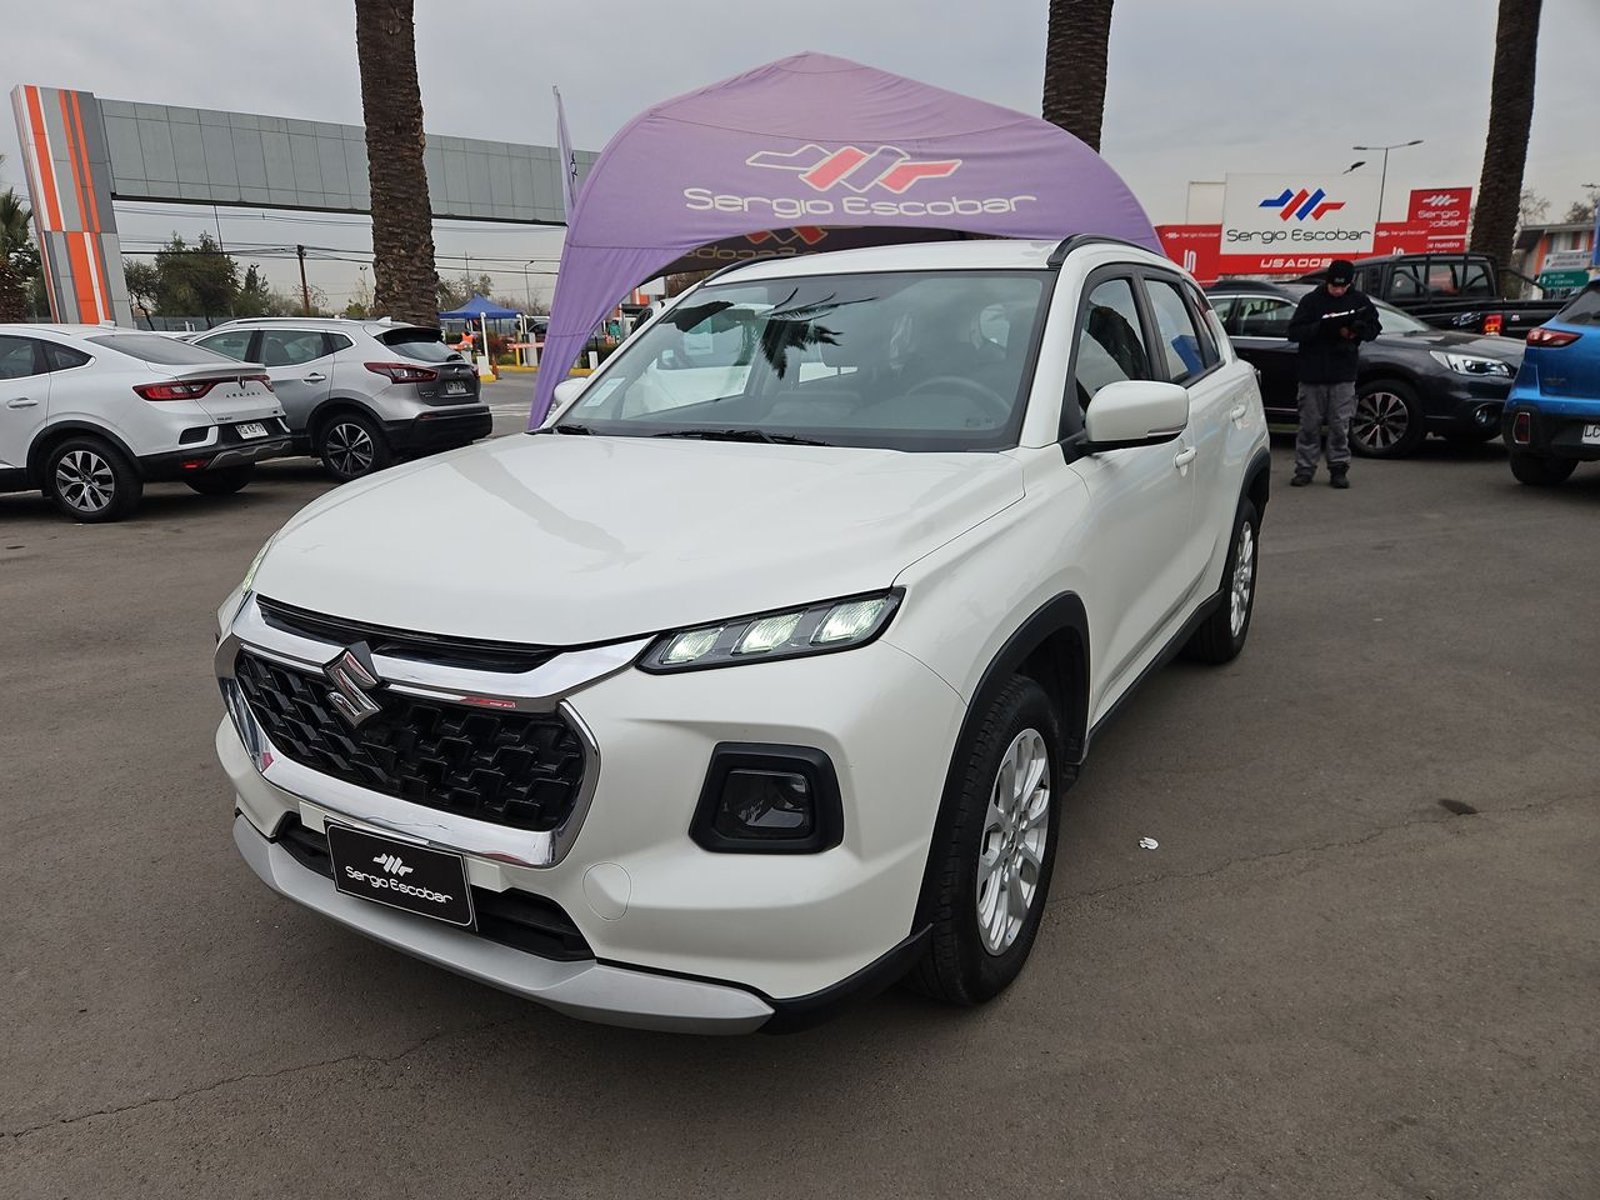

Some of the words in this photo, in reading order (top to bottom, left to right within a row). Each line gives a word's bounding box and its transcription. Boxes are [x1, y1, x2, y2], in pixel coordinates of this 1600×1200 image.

[683, 188, 834, 219] Sergio
[842, 195, 1037, 215] Escobar
[1226, 229, 1287, 244] Sergio
[1291, 229, 1371, 242] Escobar
[1260, 258, 1333, 268] USADOS
[344, 865, 389, 888] Sergio
[389, 878, 453, 903] Escobar
